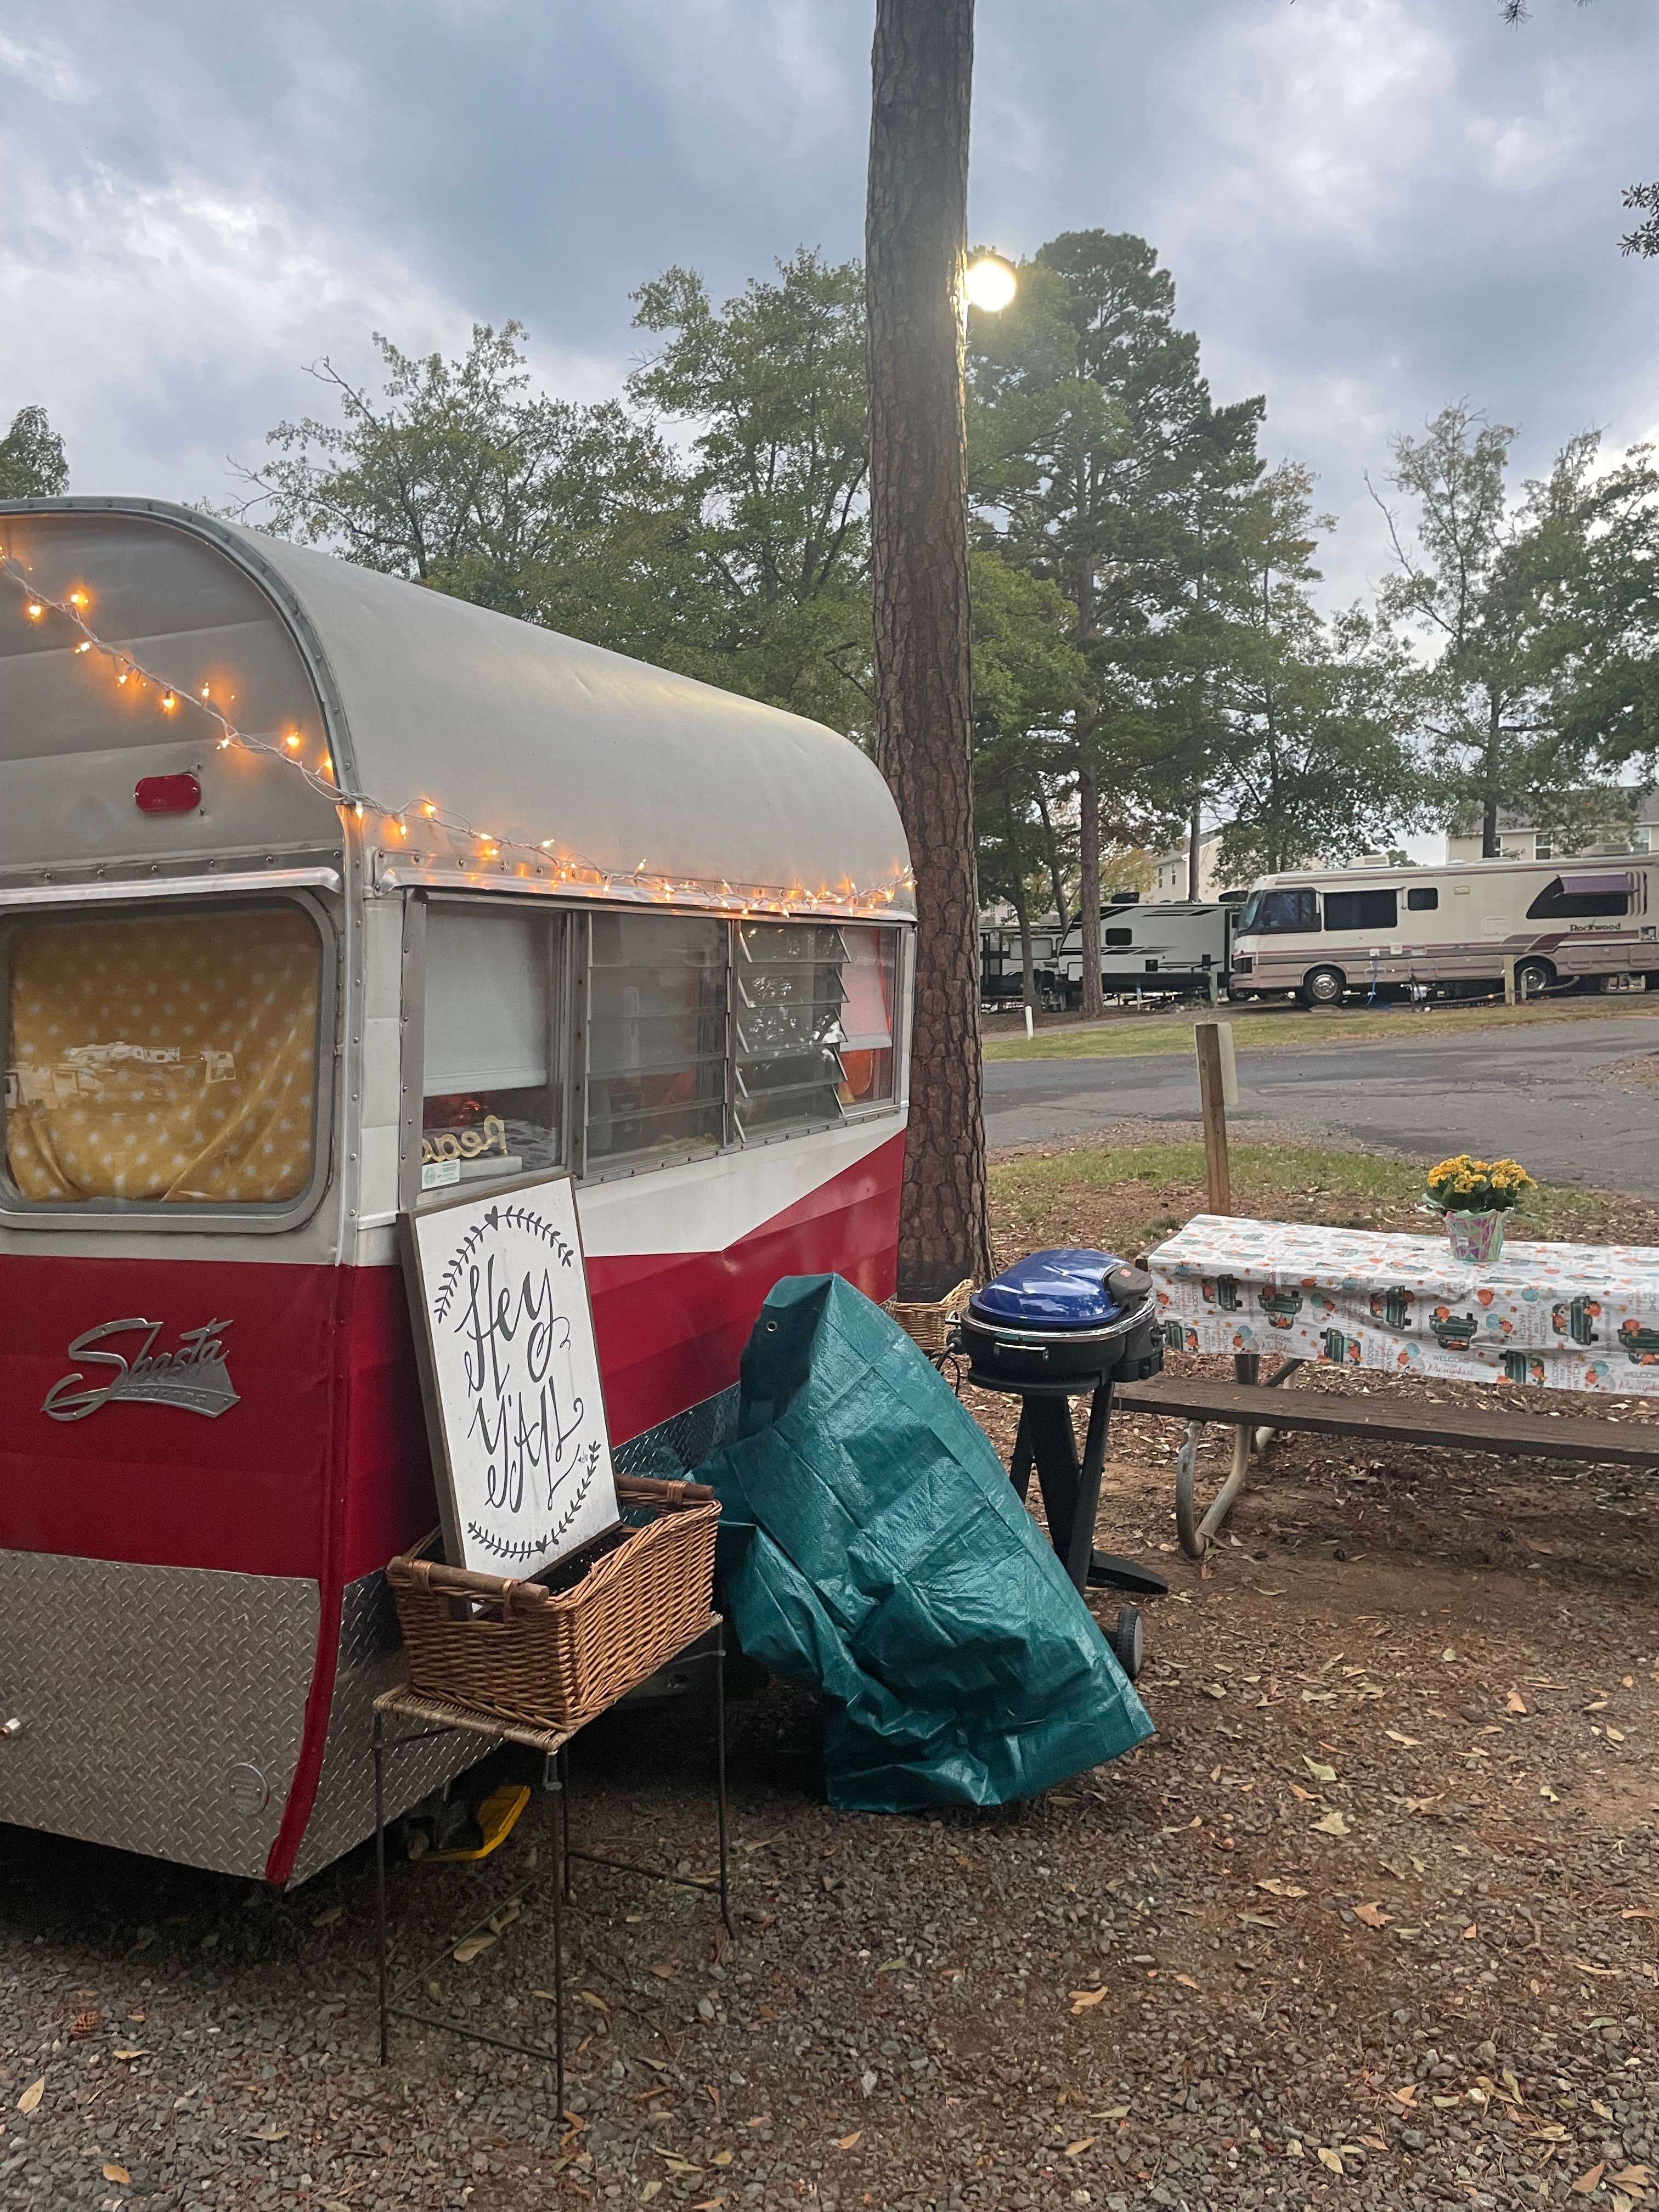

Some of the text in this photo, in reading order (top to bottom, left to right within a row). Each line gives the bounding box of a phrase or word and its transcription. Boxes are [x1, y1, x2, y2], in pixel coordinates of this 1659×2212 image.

[1570, 921, 1621, 932] Rockwood
[41, 1318, 234, 1421] Shasta
[455, 1254, 571, 1401] Hey
